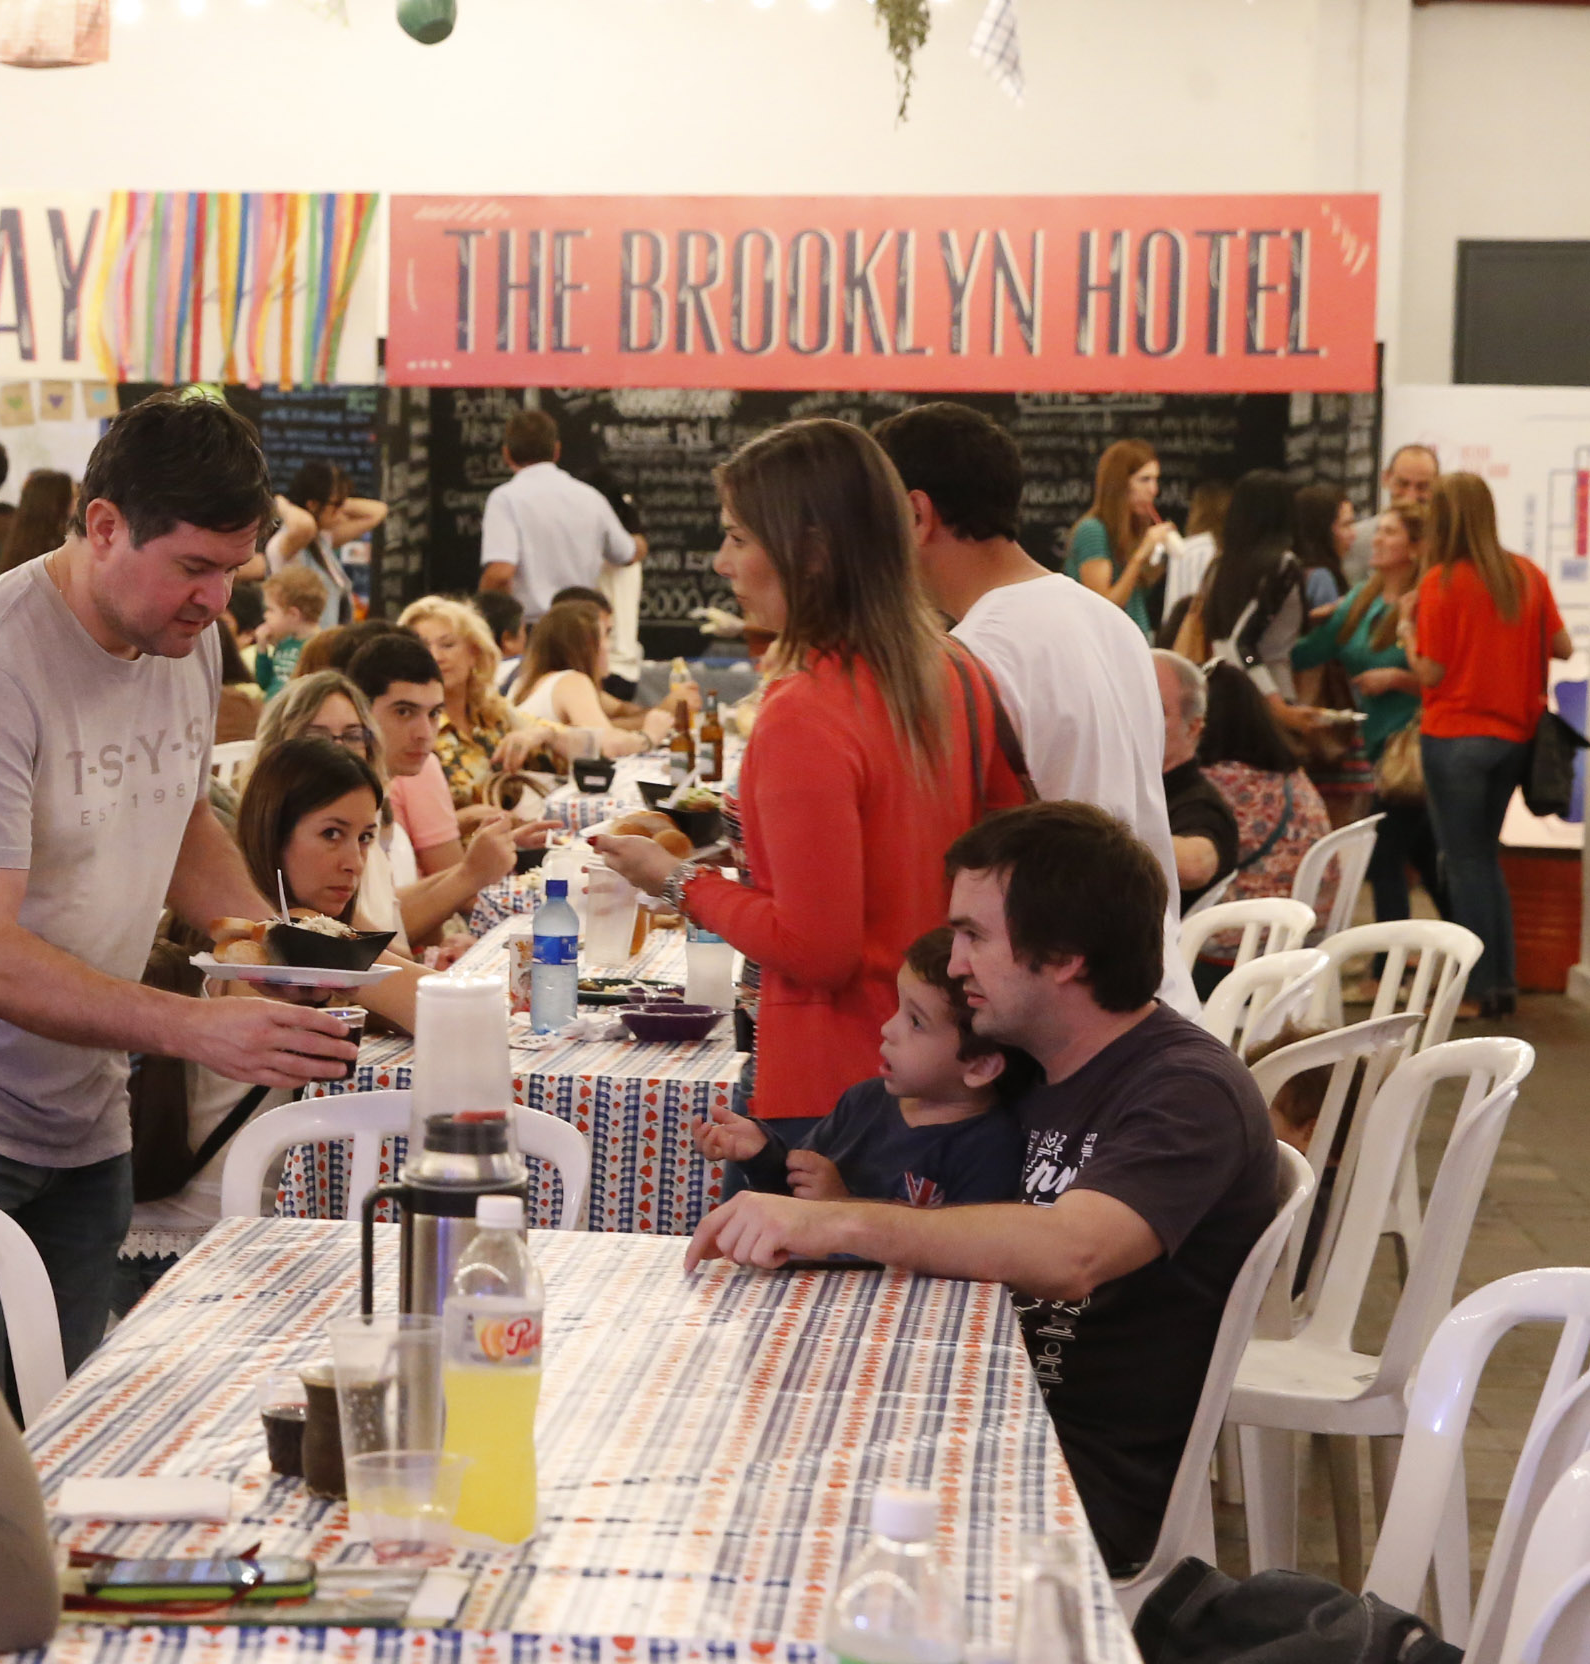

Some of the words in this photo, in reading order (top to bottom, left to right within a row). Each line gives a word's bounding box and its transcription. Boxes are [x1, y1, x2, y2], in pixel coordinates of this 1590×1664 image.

[443, 227, 592, 355] THE
[619, 227, 1046, 358] BROOKLYN
[1077, 228, 1328, 359] HOTEL
